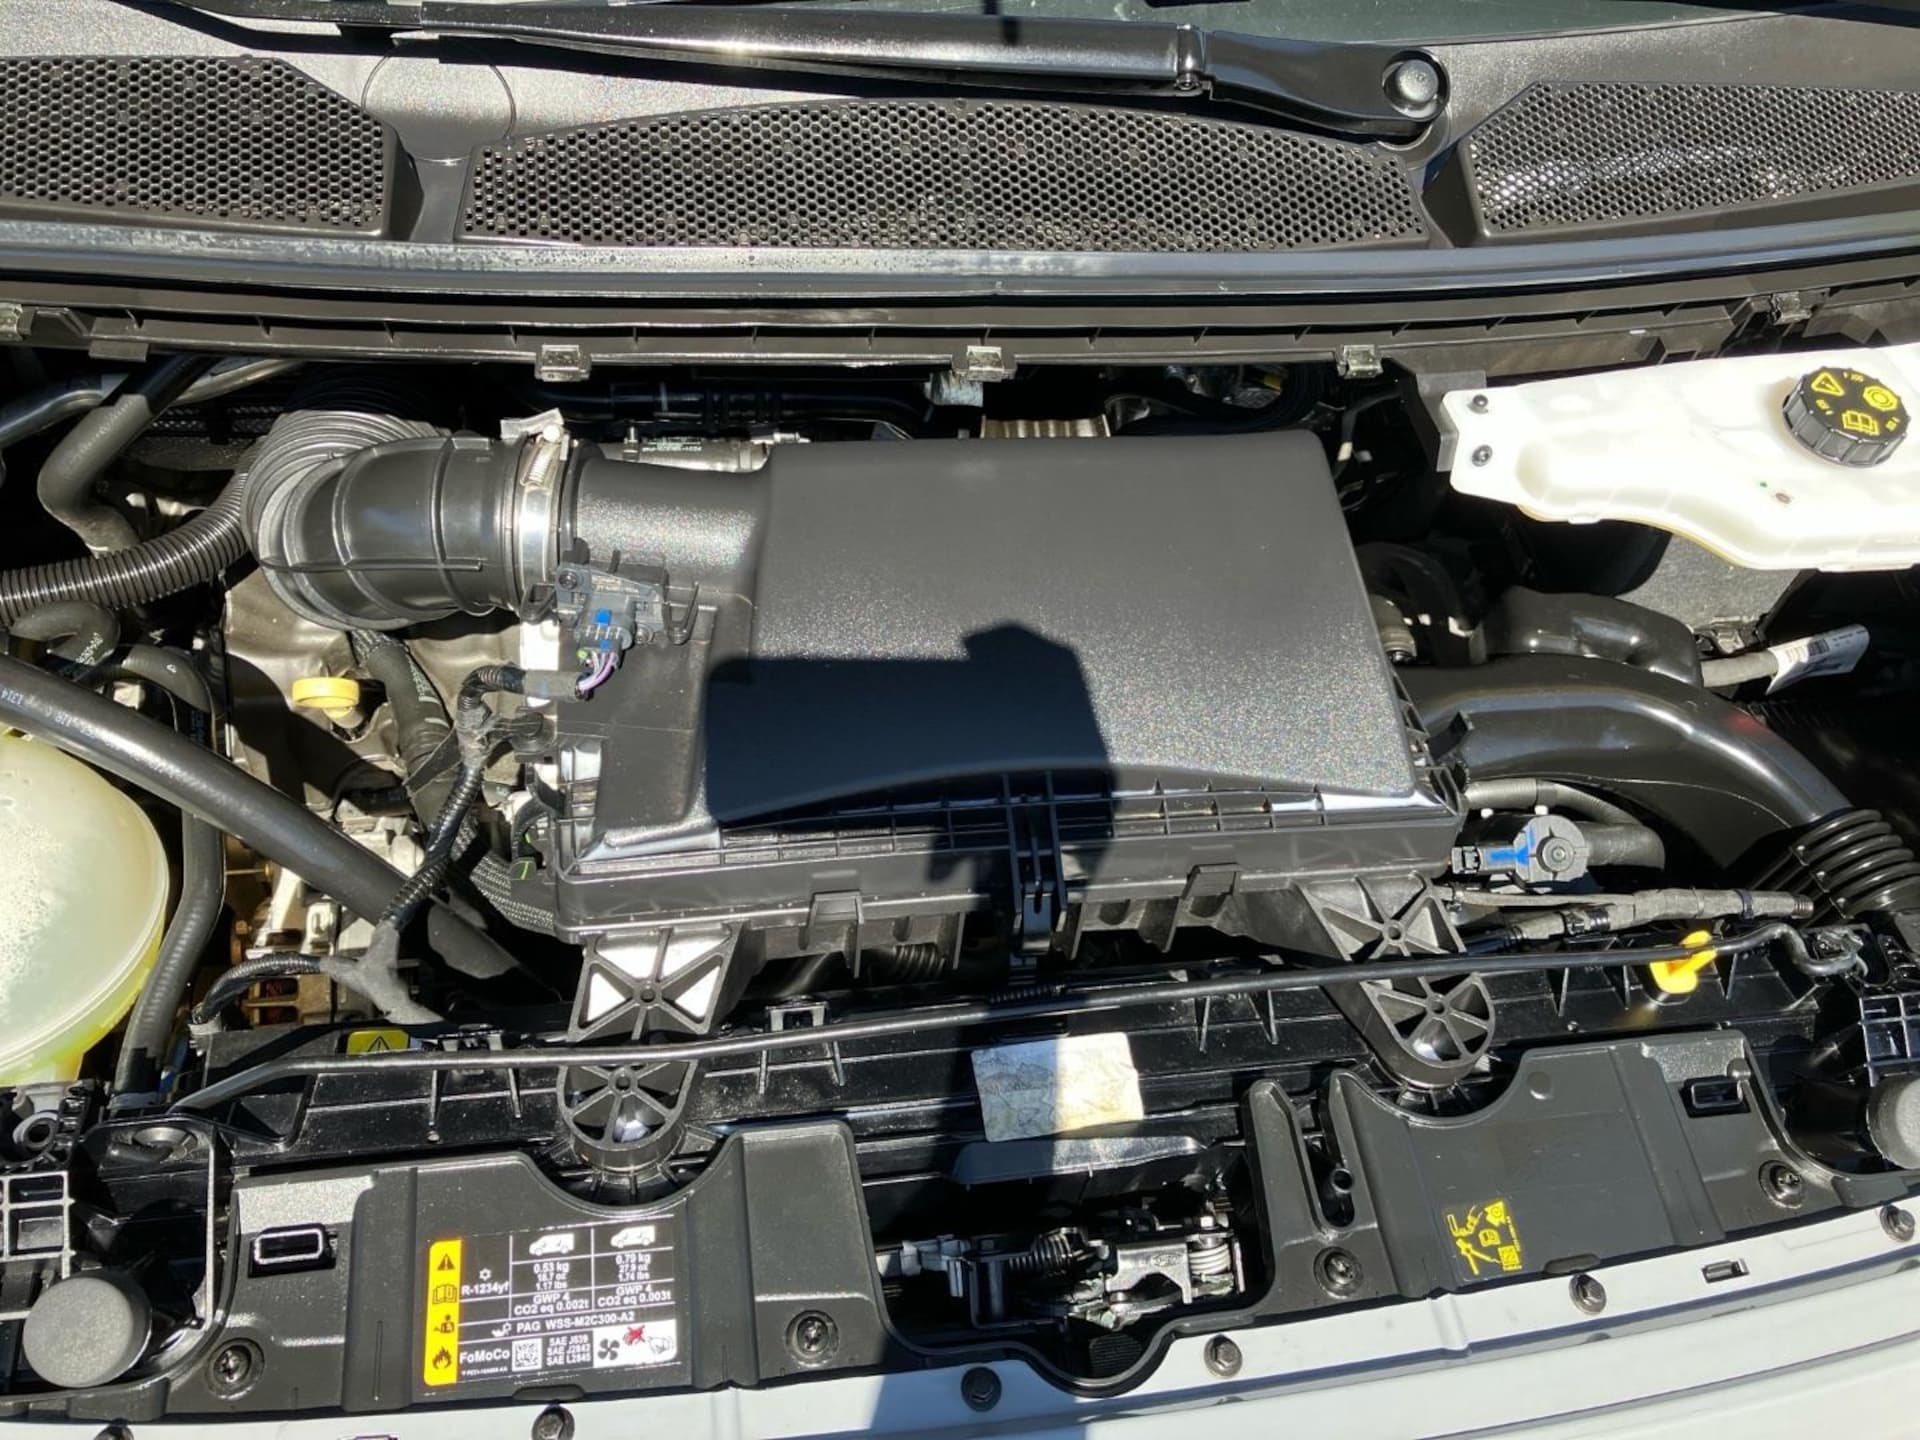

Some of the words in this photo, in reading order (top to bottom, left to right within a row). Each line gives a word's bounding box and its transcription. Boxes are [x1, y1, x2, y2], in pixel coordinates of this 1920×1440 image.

[638, 1253, 651, 1264] kg
[556, 1261, 569, 1273] kg
[461, 1281, 509, 1296] R-1234yf
[615, 1285, 643, 1296] GWP
[645, 1283, 652, 1292] 4
[532, 1293, 561, 1305] GWP
[562, 1291, 570, 1300] 4
[597, 1296, 621, 1307] CO2
[623, 1296, 637, 1305] eq
[514, 1304, 538, 1316] CO2
[540, 1304, 554, 1314] eq
[516, 1320, 541, 1333] PAG
[545, 1311, 635, 1330] WSS-M2C300-A2
[459, 1348, 511, 1364] FoMoCo
[547, 1345, 565, 1356] SAE
[546, 1354, 565, 1366] SAE
